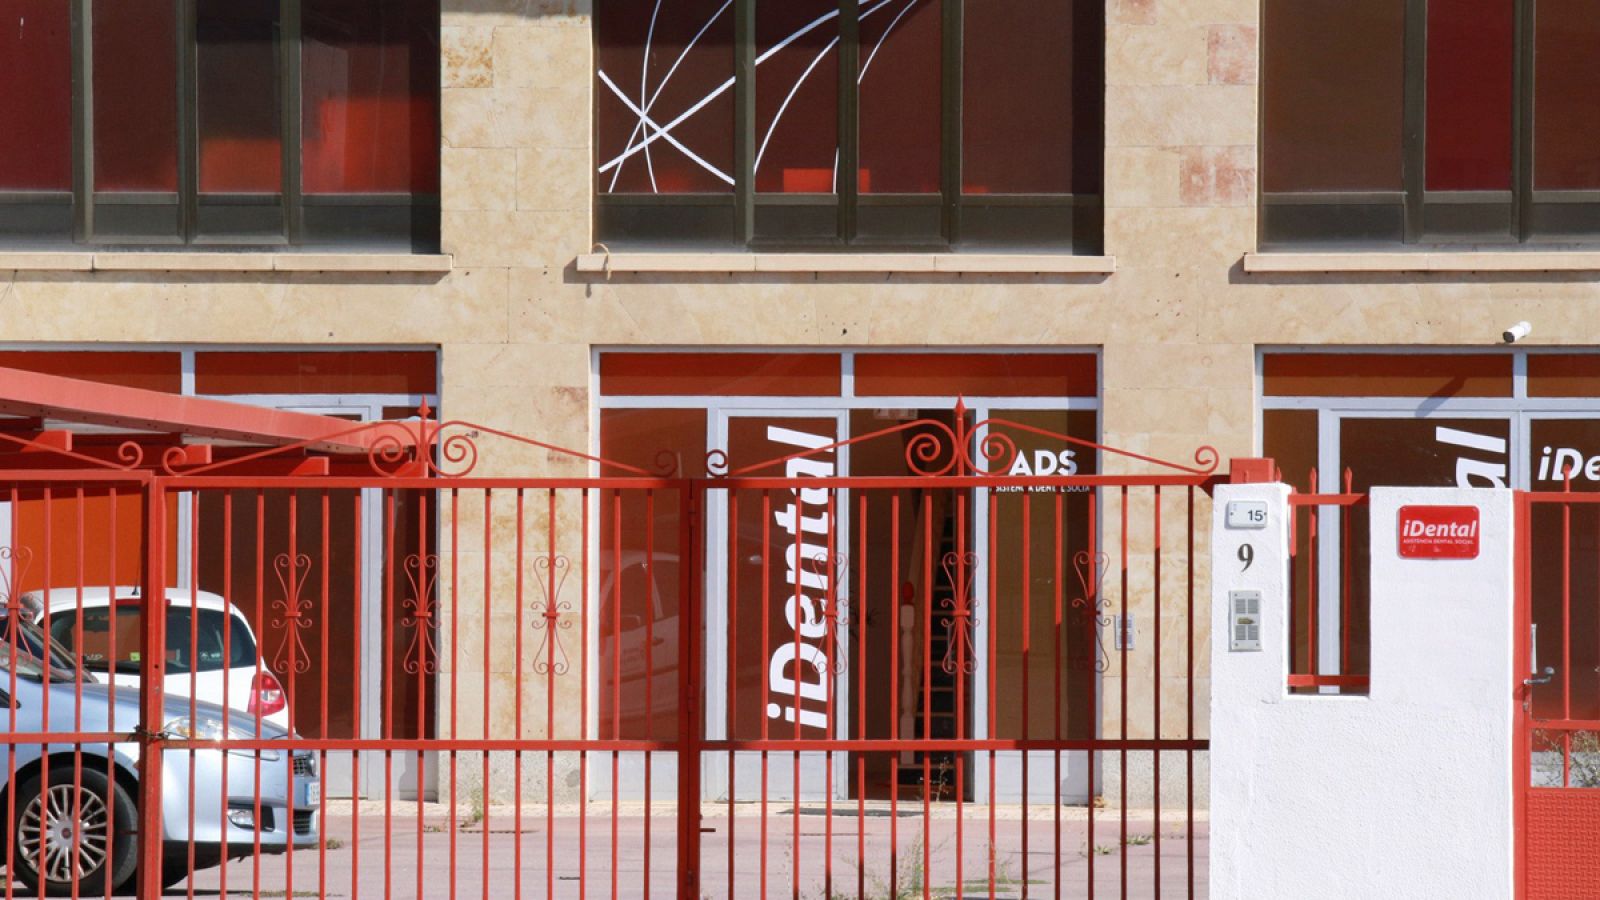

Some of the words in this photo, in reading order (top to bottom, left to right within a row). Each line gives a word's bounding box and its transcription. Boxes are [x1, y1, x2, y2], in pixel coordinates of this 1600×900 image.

[1008, 449, 1077, 476] ADS
[1247, 509, 1264, 522] 15
[1403, 520, 1477, 537] iDental
[1237, 543, 1255, 573] 9
[767, 425, 834, 729] iDental
